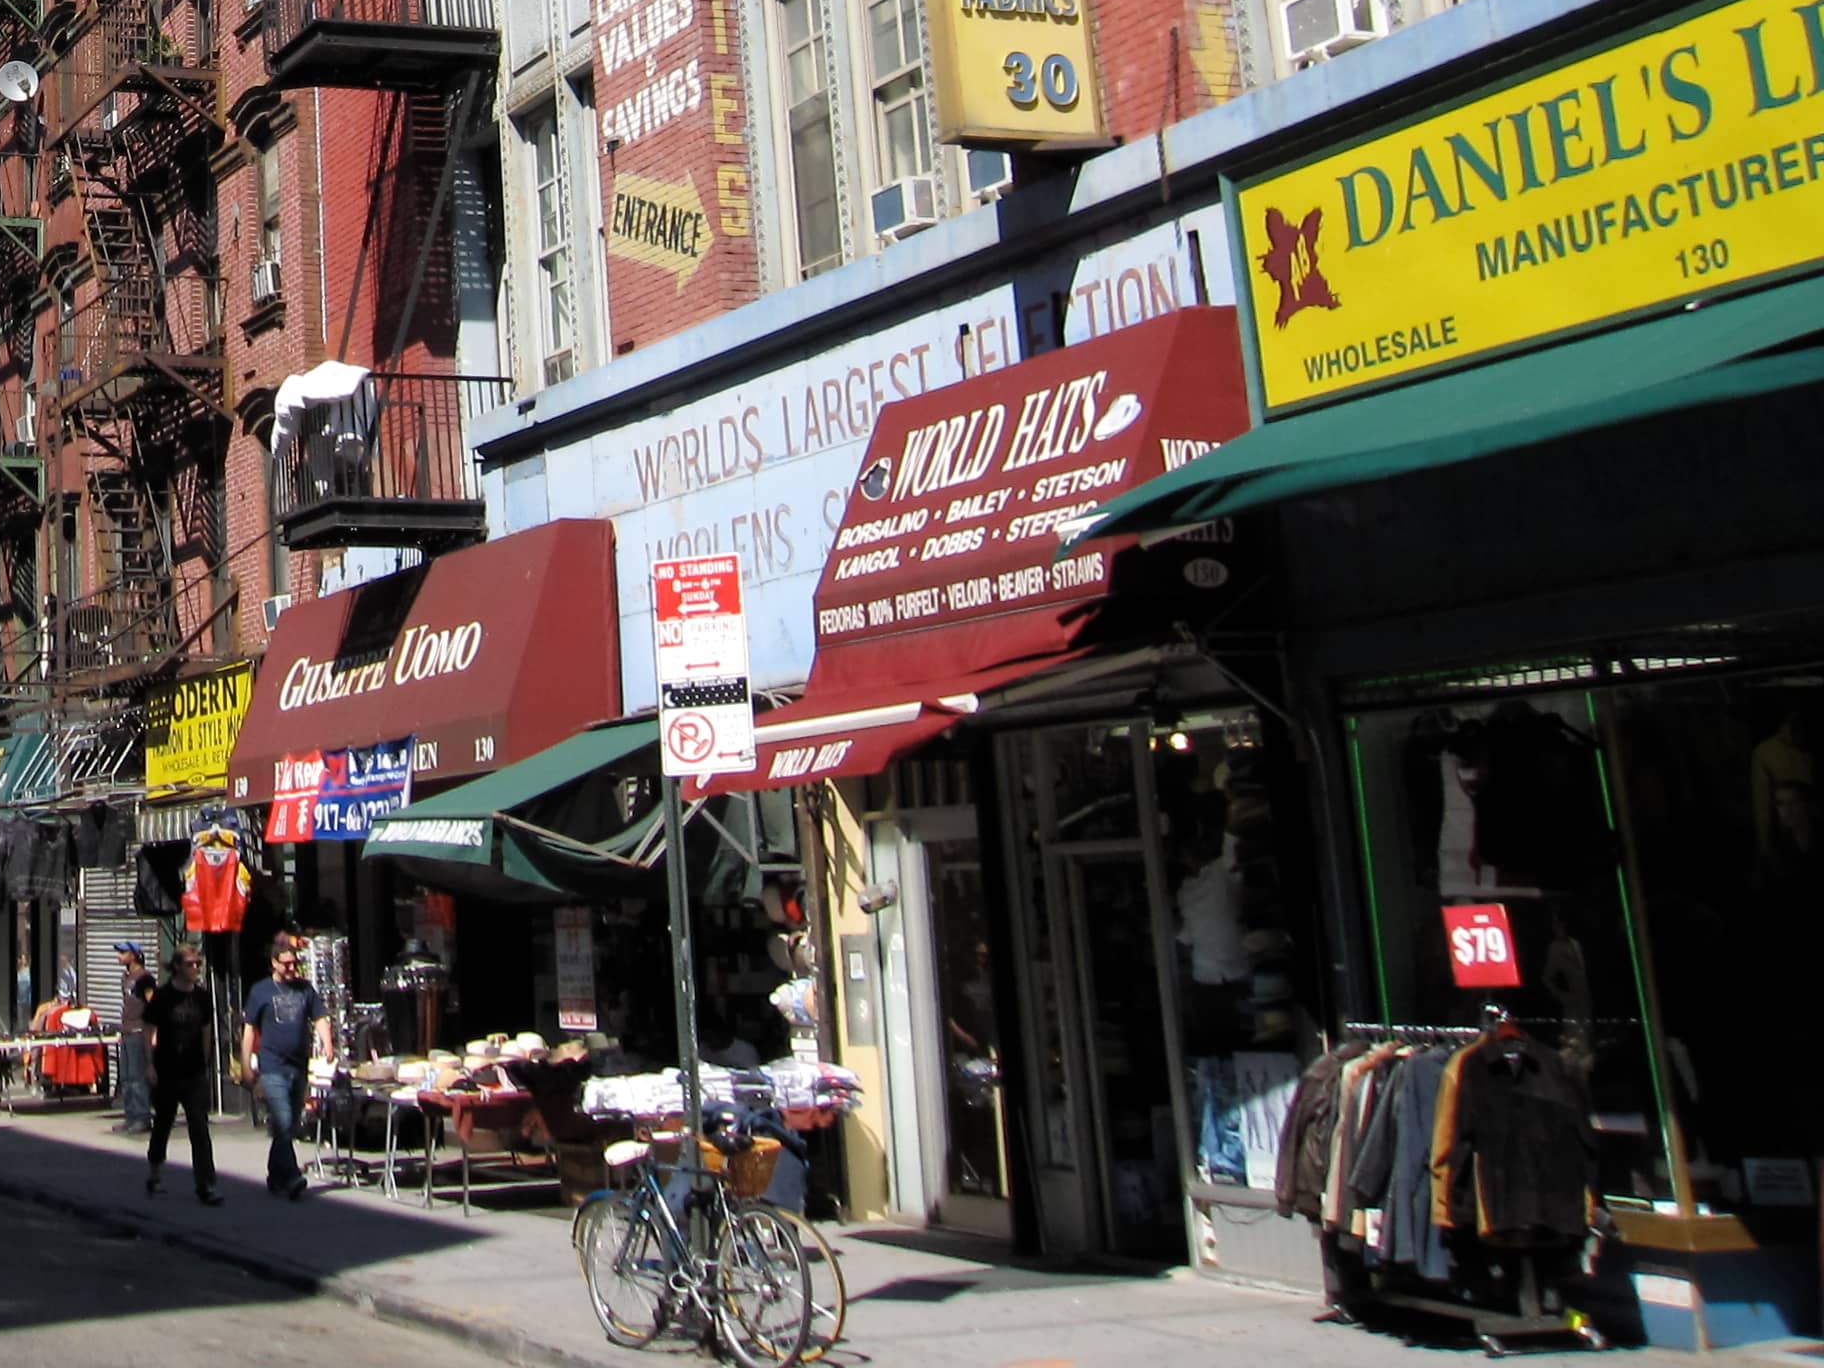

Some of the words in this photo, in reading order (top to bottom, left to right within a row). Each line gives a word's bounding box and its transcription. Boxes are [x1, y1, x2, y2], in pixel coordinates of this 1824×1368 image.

[601, 58, 703, 155] SAVINGS
[1336, 42, 1714, 254] DANIEL'S
[612, 192, 703, 259] ENTRANCE
[1674, 238, 1730, 281] 130
[1303, 315, 1459, 384] WHOLESALE
[890, 402, 1007, 504] WORLD
[1001, 369, 1109, 473] HATS
[835, 507, 929, 552] BORSALINO
[945, 486, 1012, 524] BAILEY
[1030, 457, 1129, 503] STETSON
[658, 565, 675, 579] NO
[679, 559, 734, 578] STANDING
[834, 550, 902, 582] KANGOL
[920, 525, 985, 563] DOBBS
[681, 591, 715, 603] SUNDAY
[818, 605, 865, 636] FEDORAS
[866, 598, 894, 628] 100%
[895, 586, 940, 621] FURFELT
[946, 576, 993, 613] VELOUR
[999, 565, 1045, 601] BEAVER
[1052, 551, 1105, 591] STRAWS
[393, 620, 483, 687] UOMO
[660, 622, 682, 646] NO
[474, 735, 495, 763] 130
